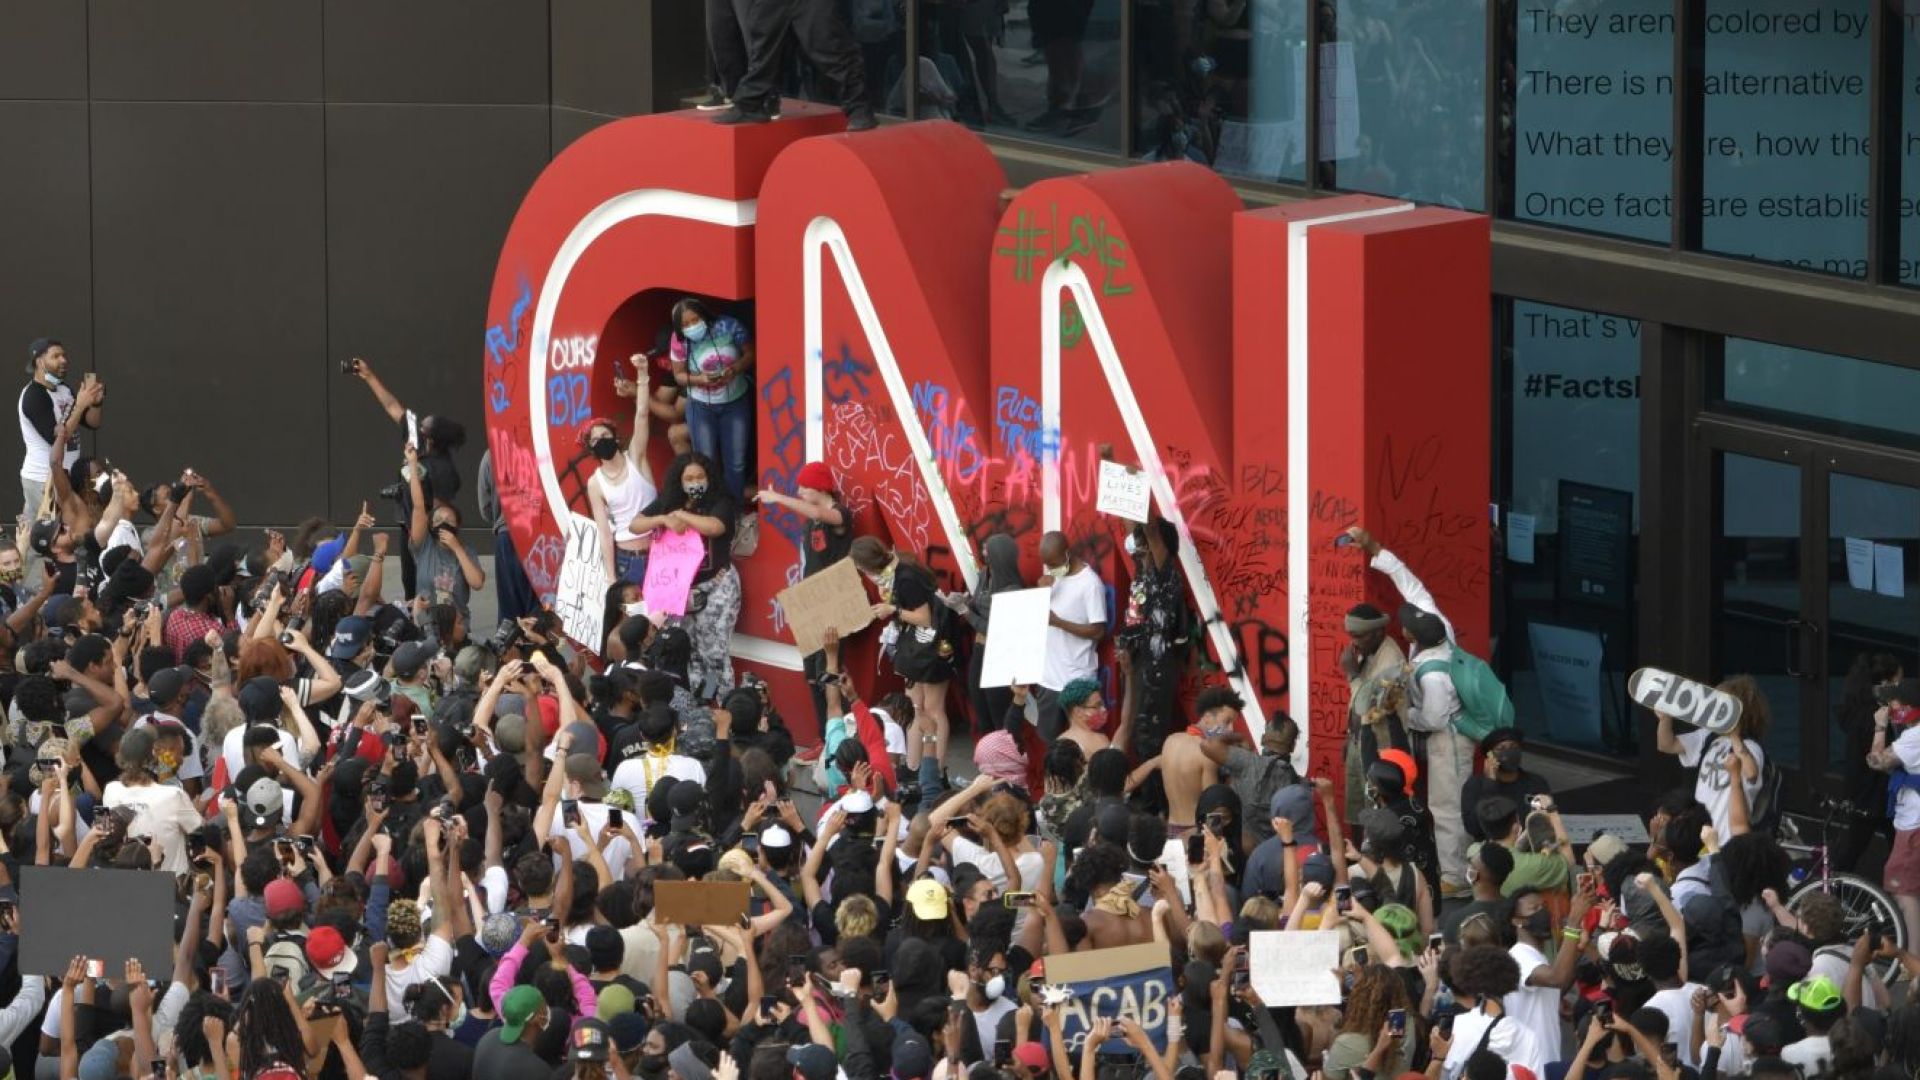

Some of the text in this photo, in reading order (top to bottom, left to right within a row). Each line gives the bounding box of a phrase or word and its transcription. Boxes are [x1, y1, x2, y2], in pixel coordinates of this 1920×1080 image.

[1525, 9, 1869, 39] They aren colored by
[1525, 70, 1864, 96] There is n alternative
[1525, 131, 1870, 162] What they re, how the
[1525, 192, 1605, 218] Once
[1613, 192, 1673, 218] fact
[1702, 197, 1747, 218] are
[1525, 311, 1617, 339] That's
[551, 334, 598, 371] OURS
[1310, 683, 1350, 705] RACI
[1641, 672, 1734, 729] FLOYD
[1060, 979, 1167, 1031] ACAB
